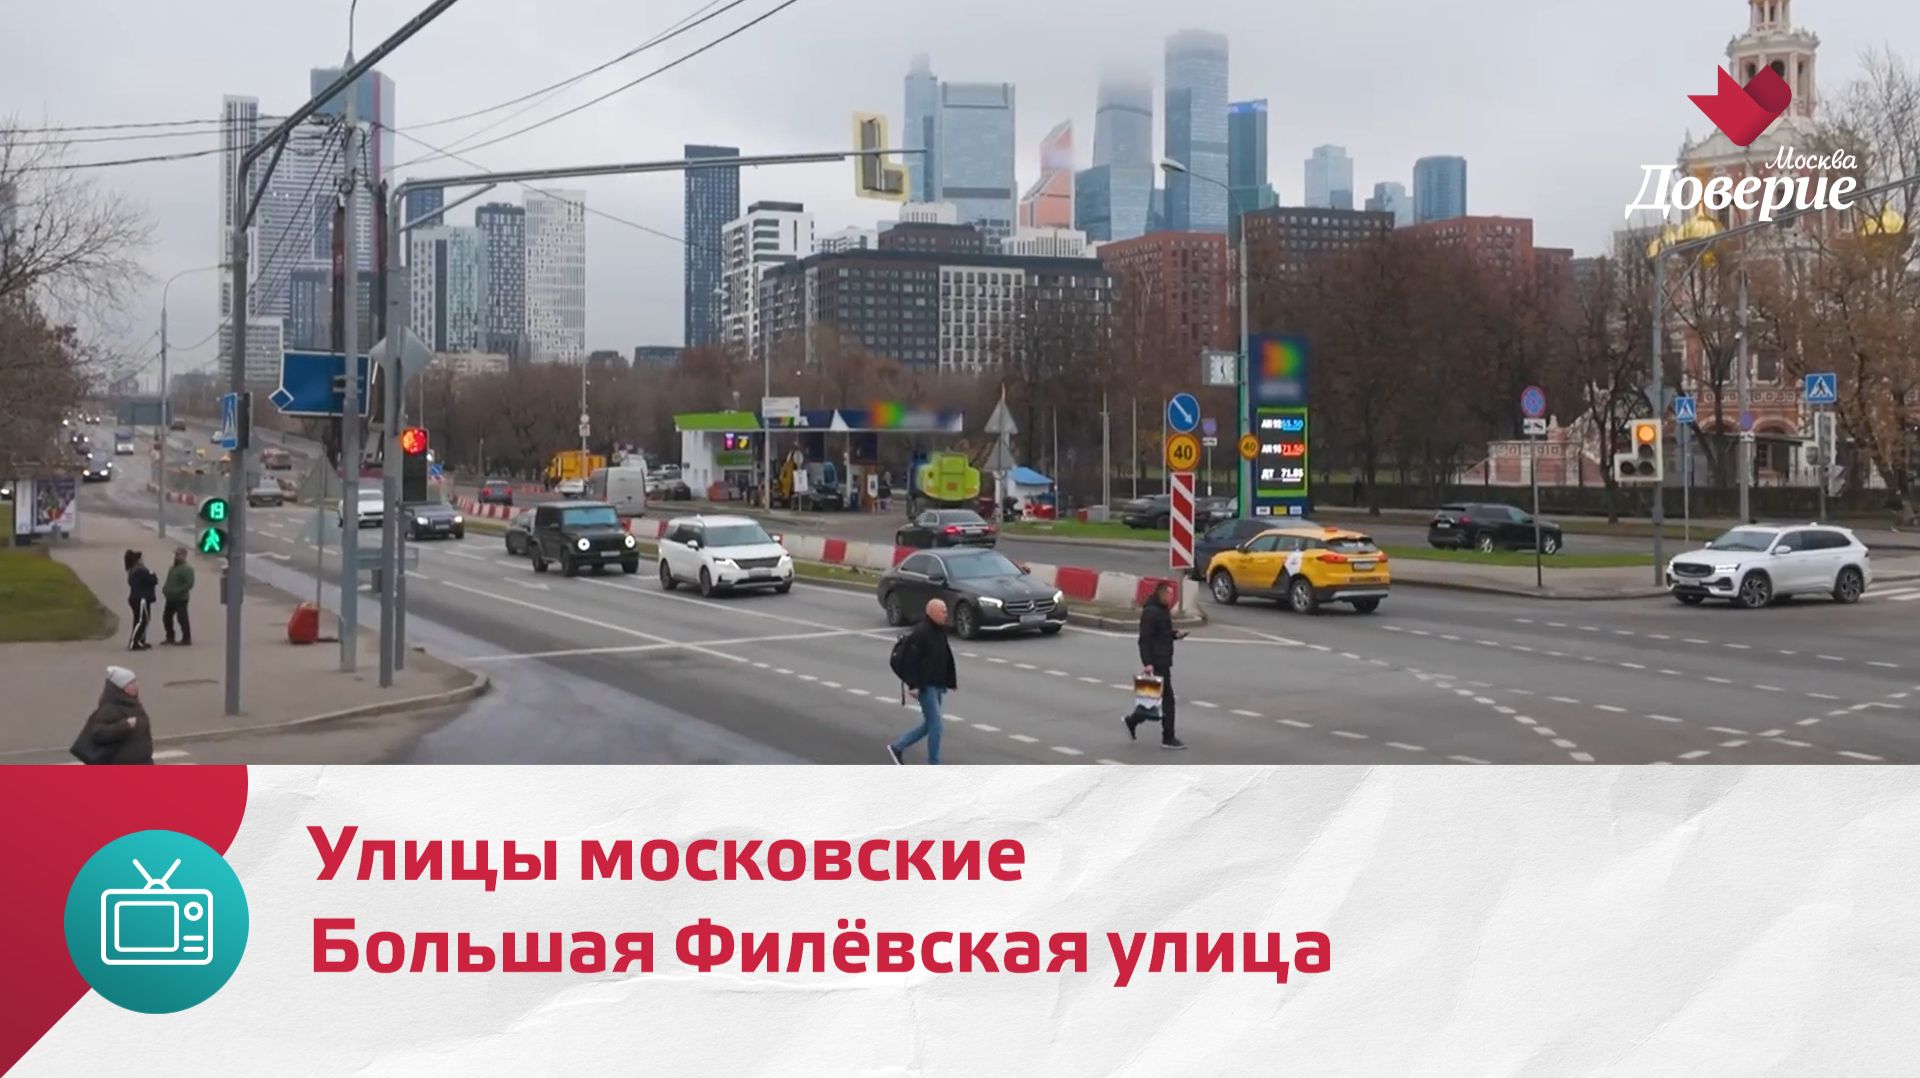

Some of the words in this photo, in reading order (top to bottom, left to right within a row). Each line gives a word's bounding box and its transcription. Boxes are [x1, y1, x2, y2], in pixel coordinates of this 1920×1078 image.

[1173, 444, 1193, 461] 40
[1243, 442, 1257, 453] 40
[210, 502, 225, 519] 19
